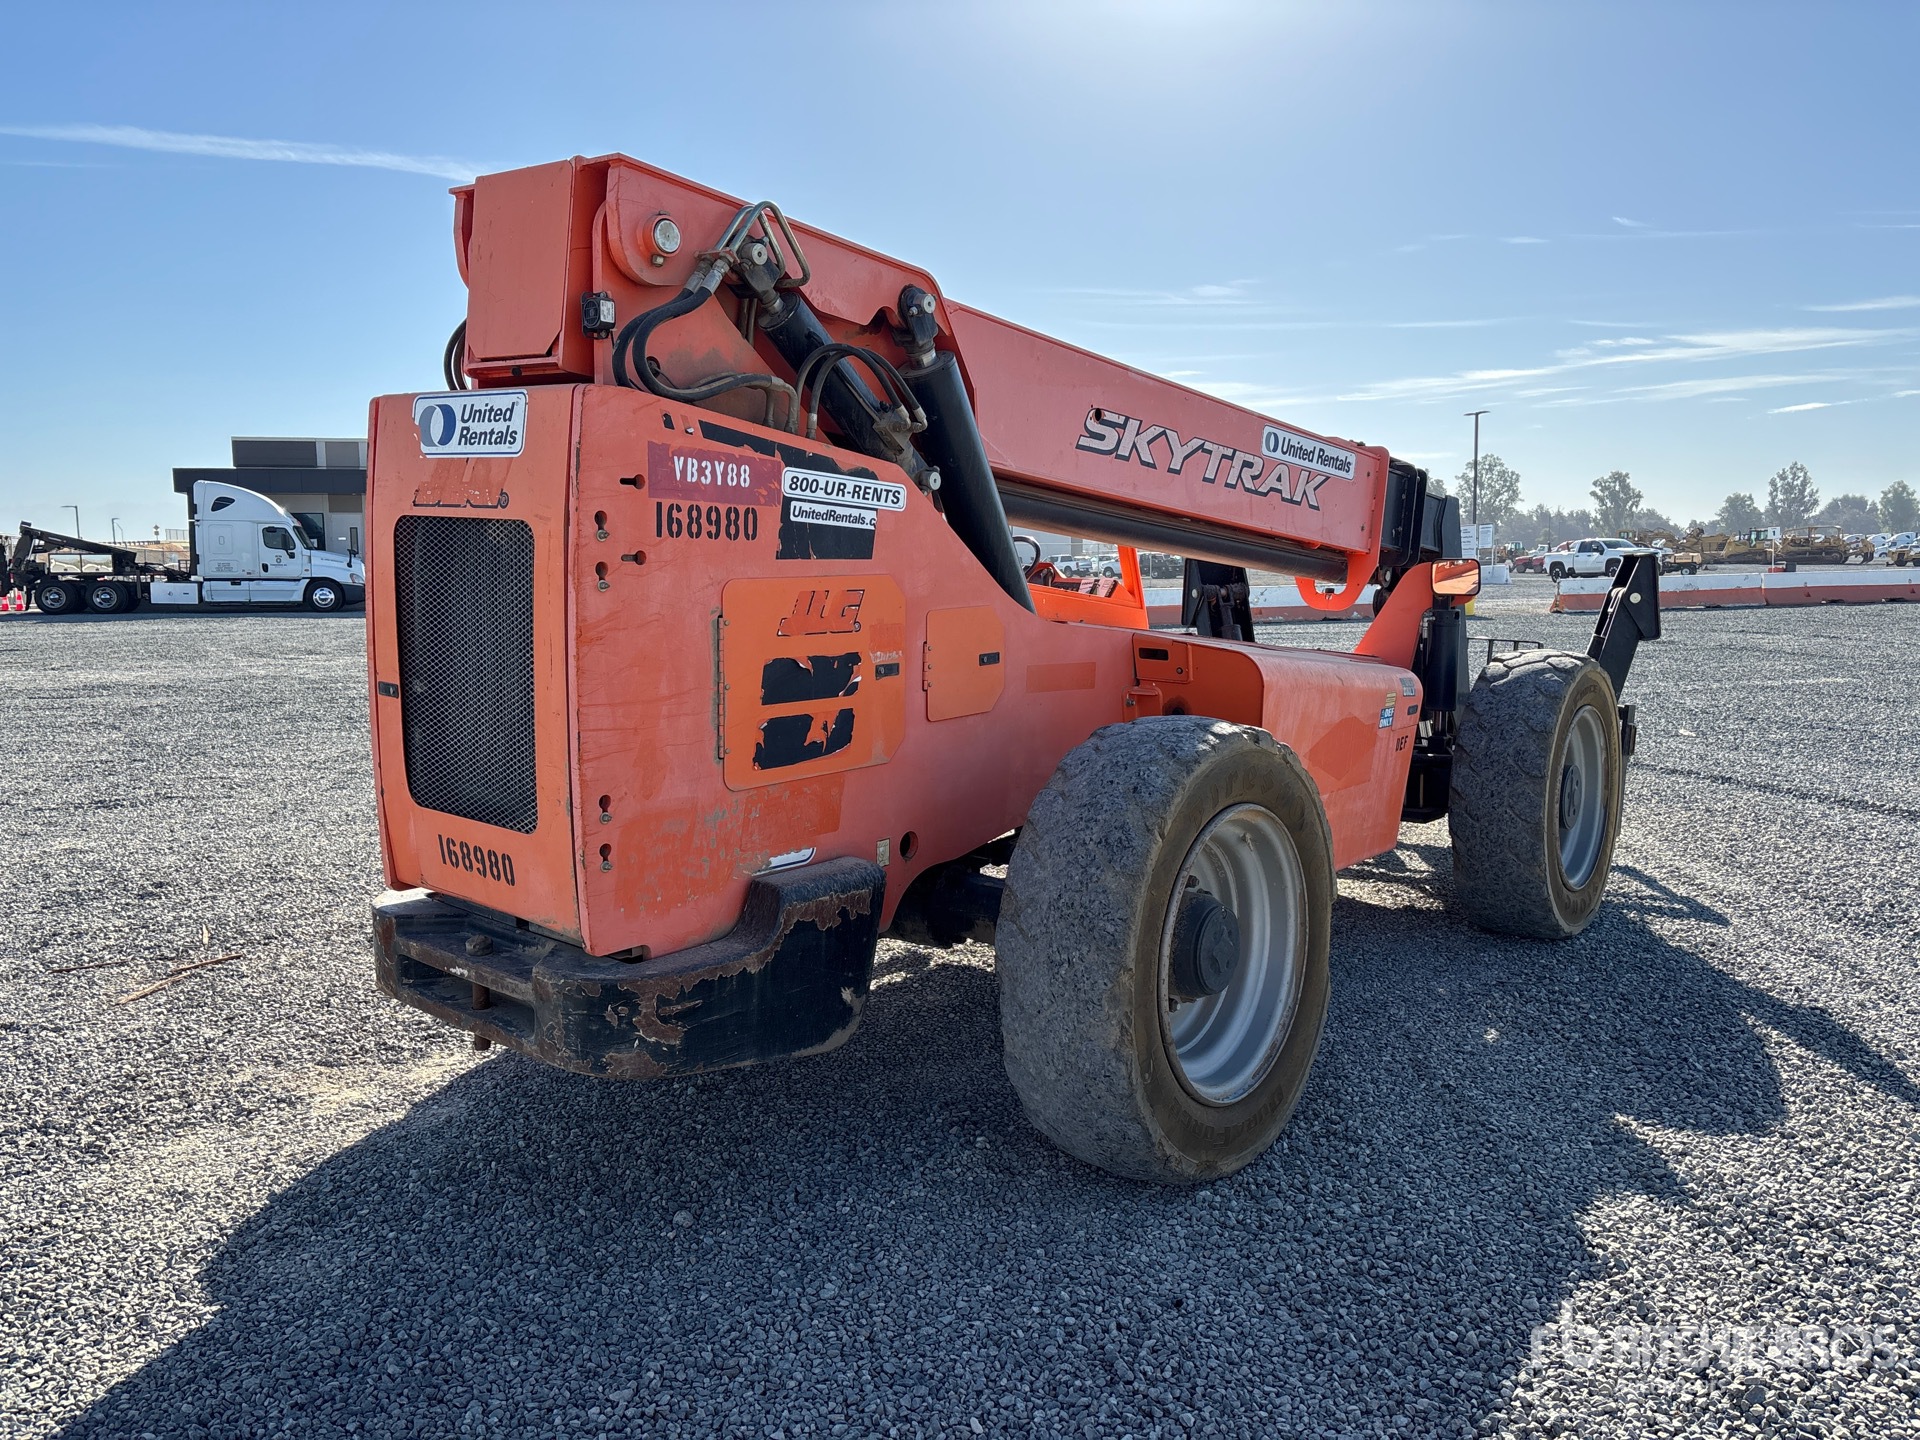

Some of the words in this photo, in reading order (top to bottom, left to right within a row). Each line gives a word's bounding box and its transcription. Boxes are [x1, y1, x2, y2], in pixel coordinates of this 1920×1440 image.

[461, 402, 516, 424] United
[458, 425, 518, 447] Rentals
[673, 455, 750, 488] VB3Y88
[1075, 408, 1331, 511] SKYTRAK
[1281, 438, 1315, 463] United
[1317, 446, 1352, 474] Rentals
[788, 475, 901, 505] 800-UR-RENTS
[656, 501, 758, 541] 168980
[1395, 735, 1408, 752] DEF
[437, 834, 516, 887] 168980
